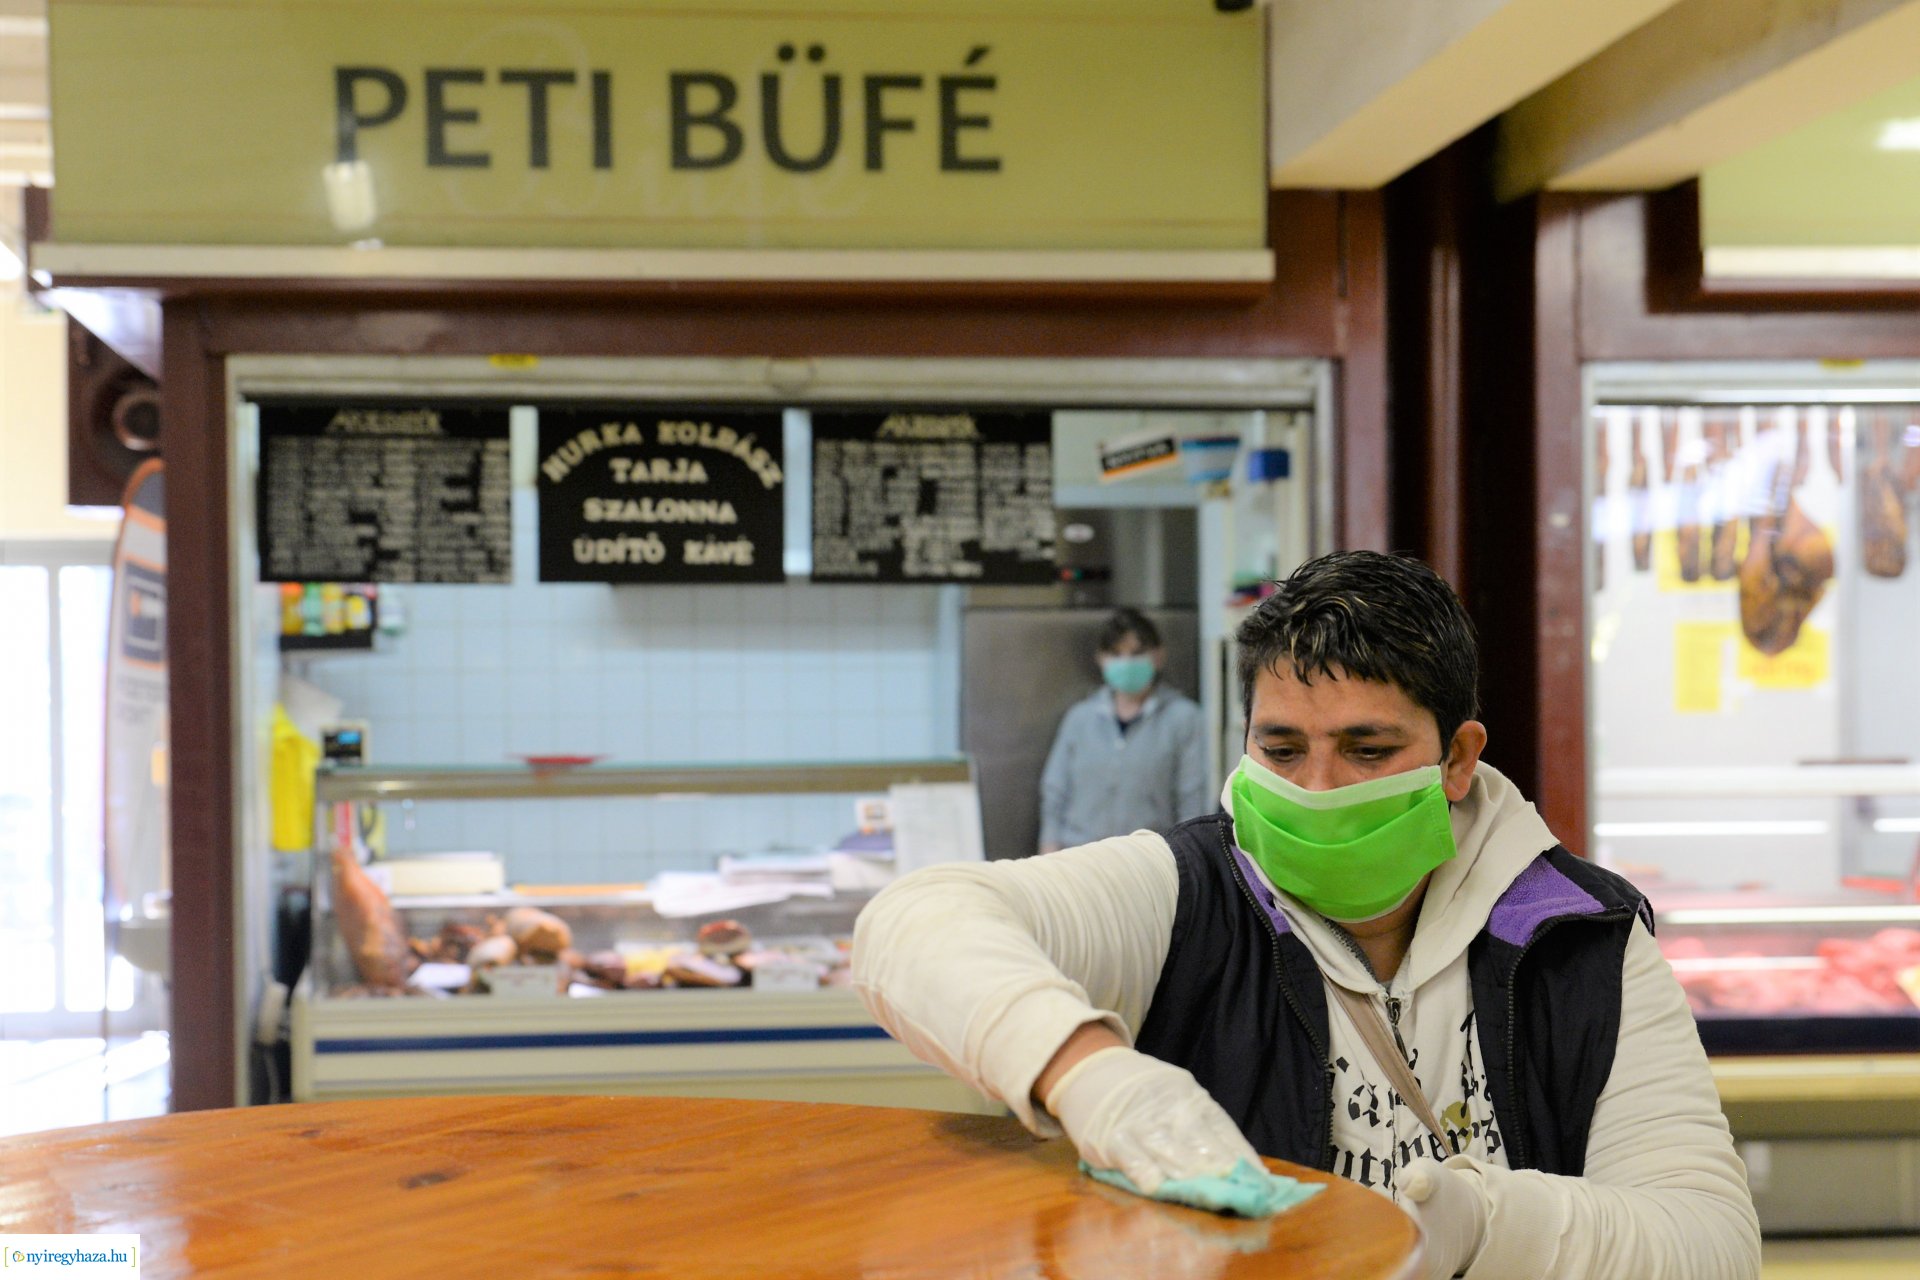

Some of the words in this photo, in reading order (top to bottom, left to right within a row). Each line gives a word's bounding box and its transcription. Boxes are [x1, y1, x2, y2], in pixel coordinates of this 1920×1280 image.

[334, 66, 613, 170] PETI
[669, 43, 1003, 173] BÜFÉ
[608, 457, 709, 484] TARJA
[583, 497, 738, 524] SZALONNA
[683, 535, 754, 566] KÁVÉ
